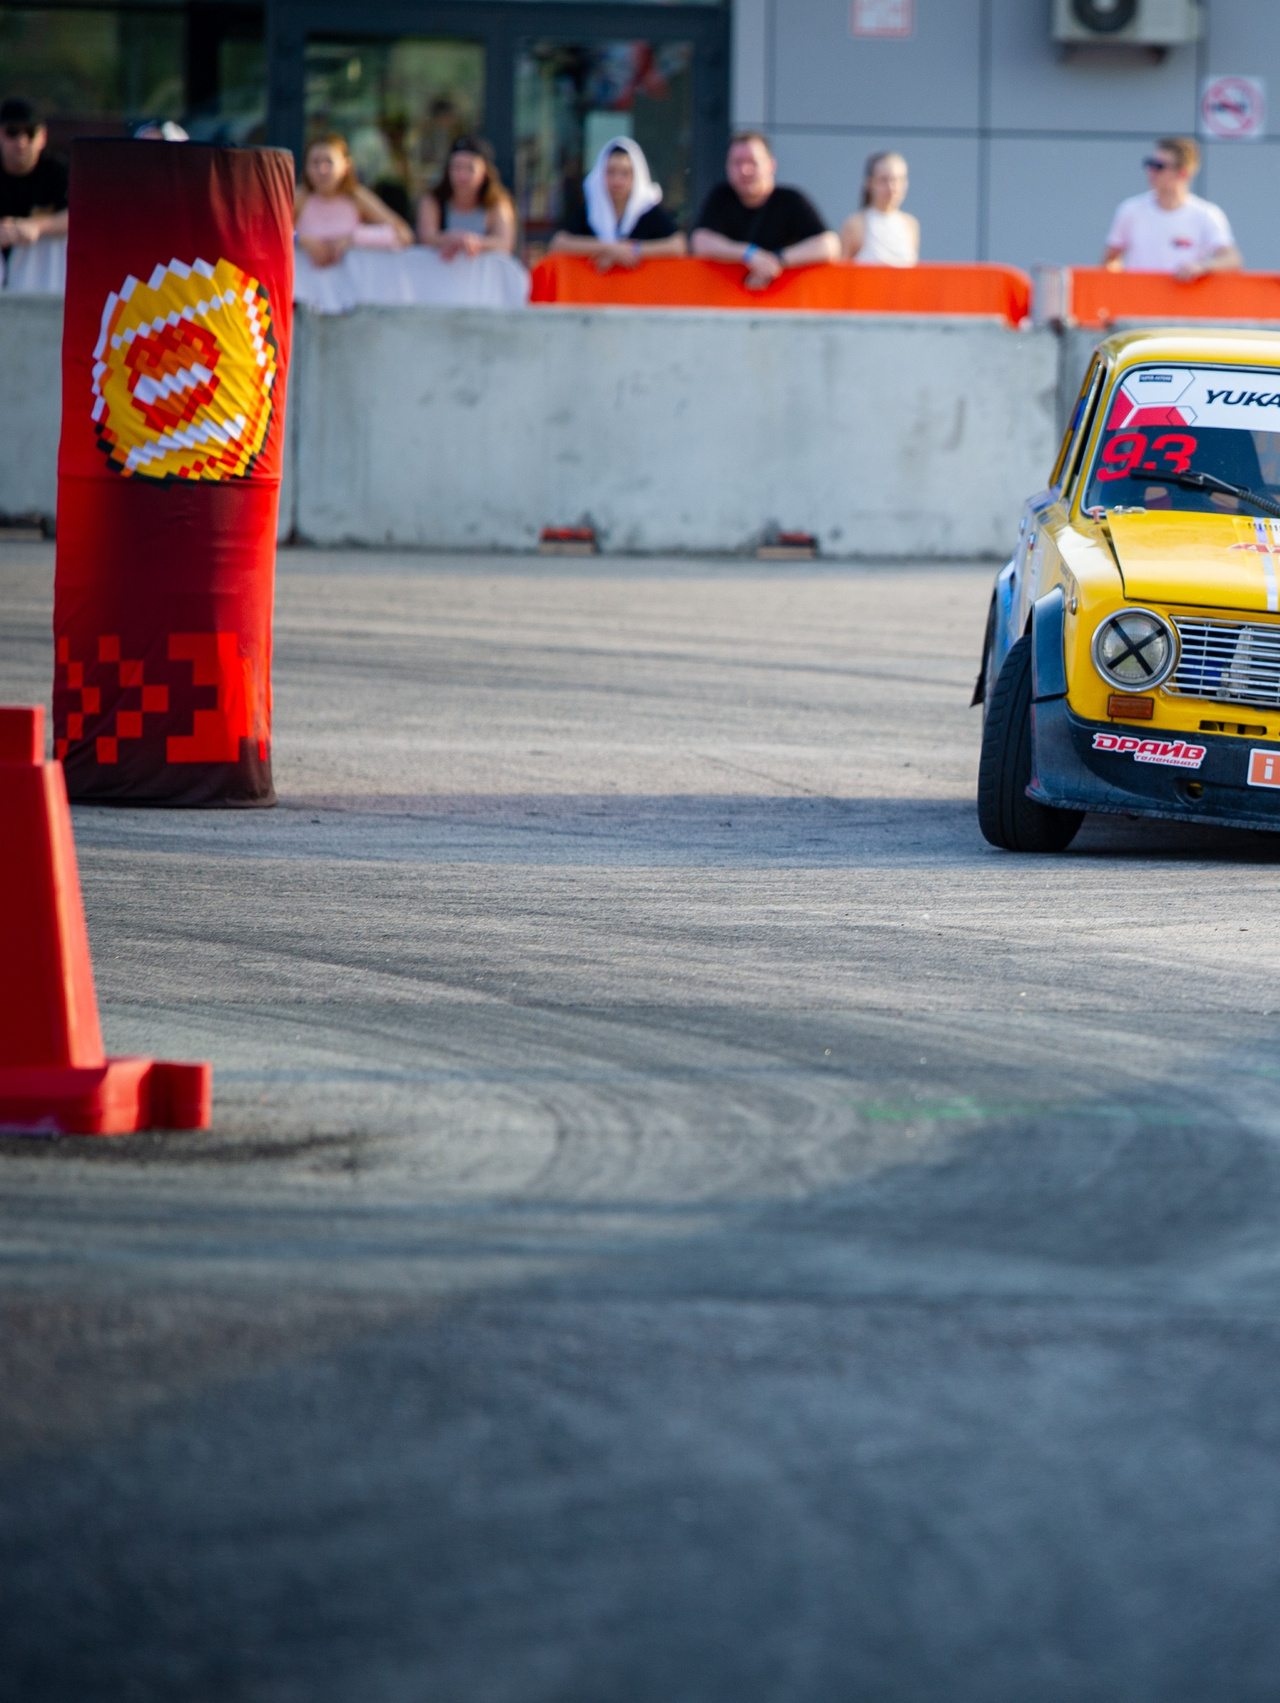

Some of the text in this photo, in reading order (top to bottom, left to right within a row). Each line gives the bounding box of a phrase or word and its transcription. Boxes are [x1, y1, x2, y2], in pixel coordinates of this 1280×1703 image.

[1096, 432, 1198, 482] 93
[1095, 734, 1205, 760] ДРАЙВ
[1134, 753, 1200, 767] телеканал
